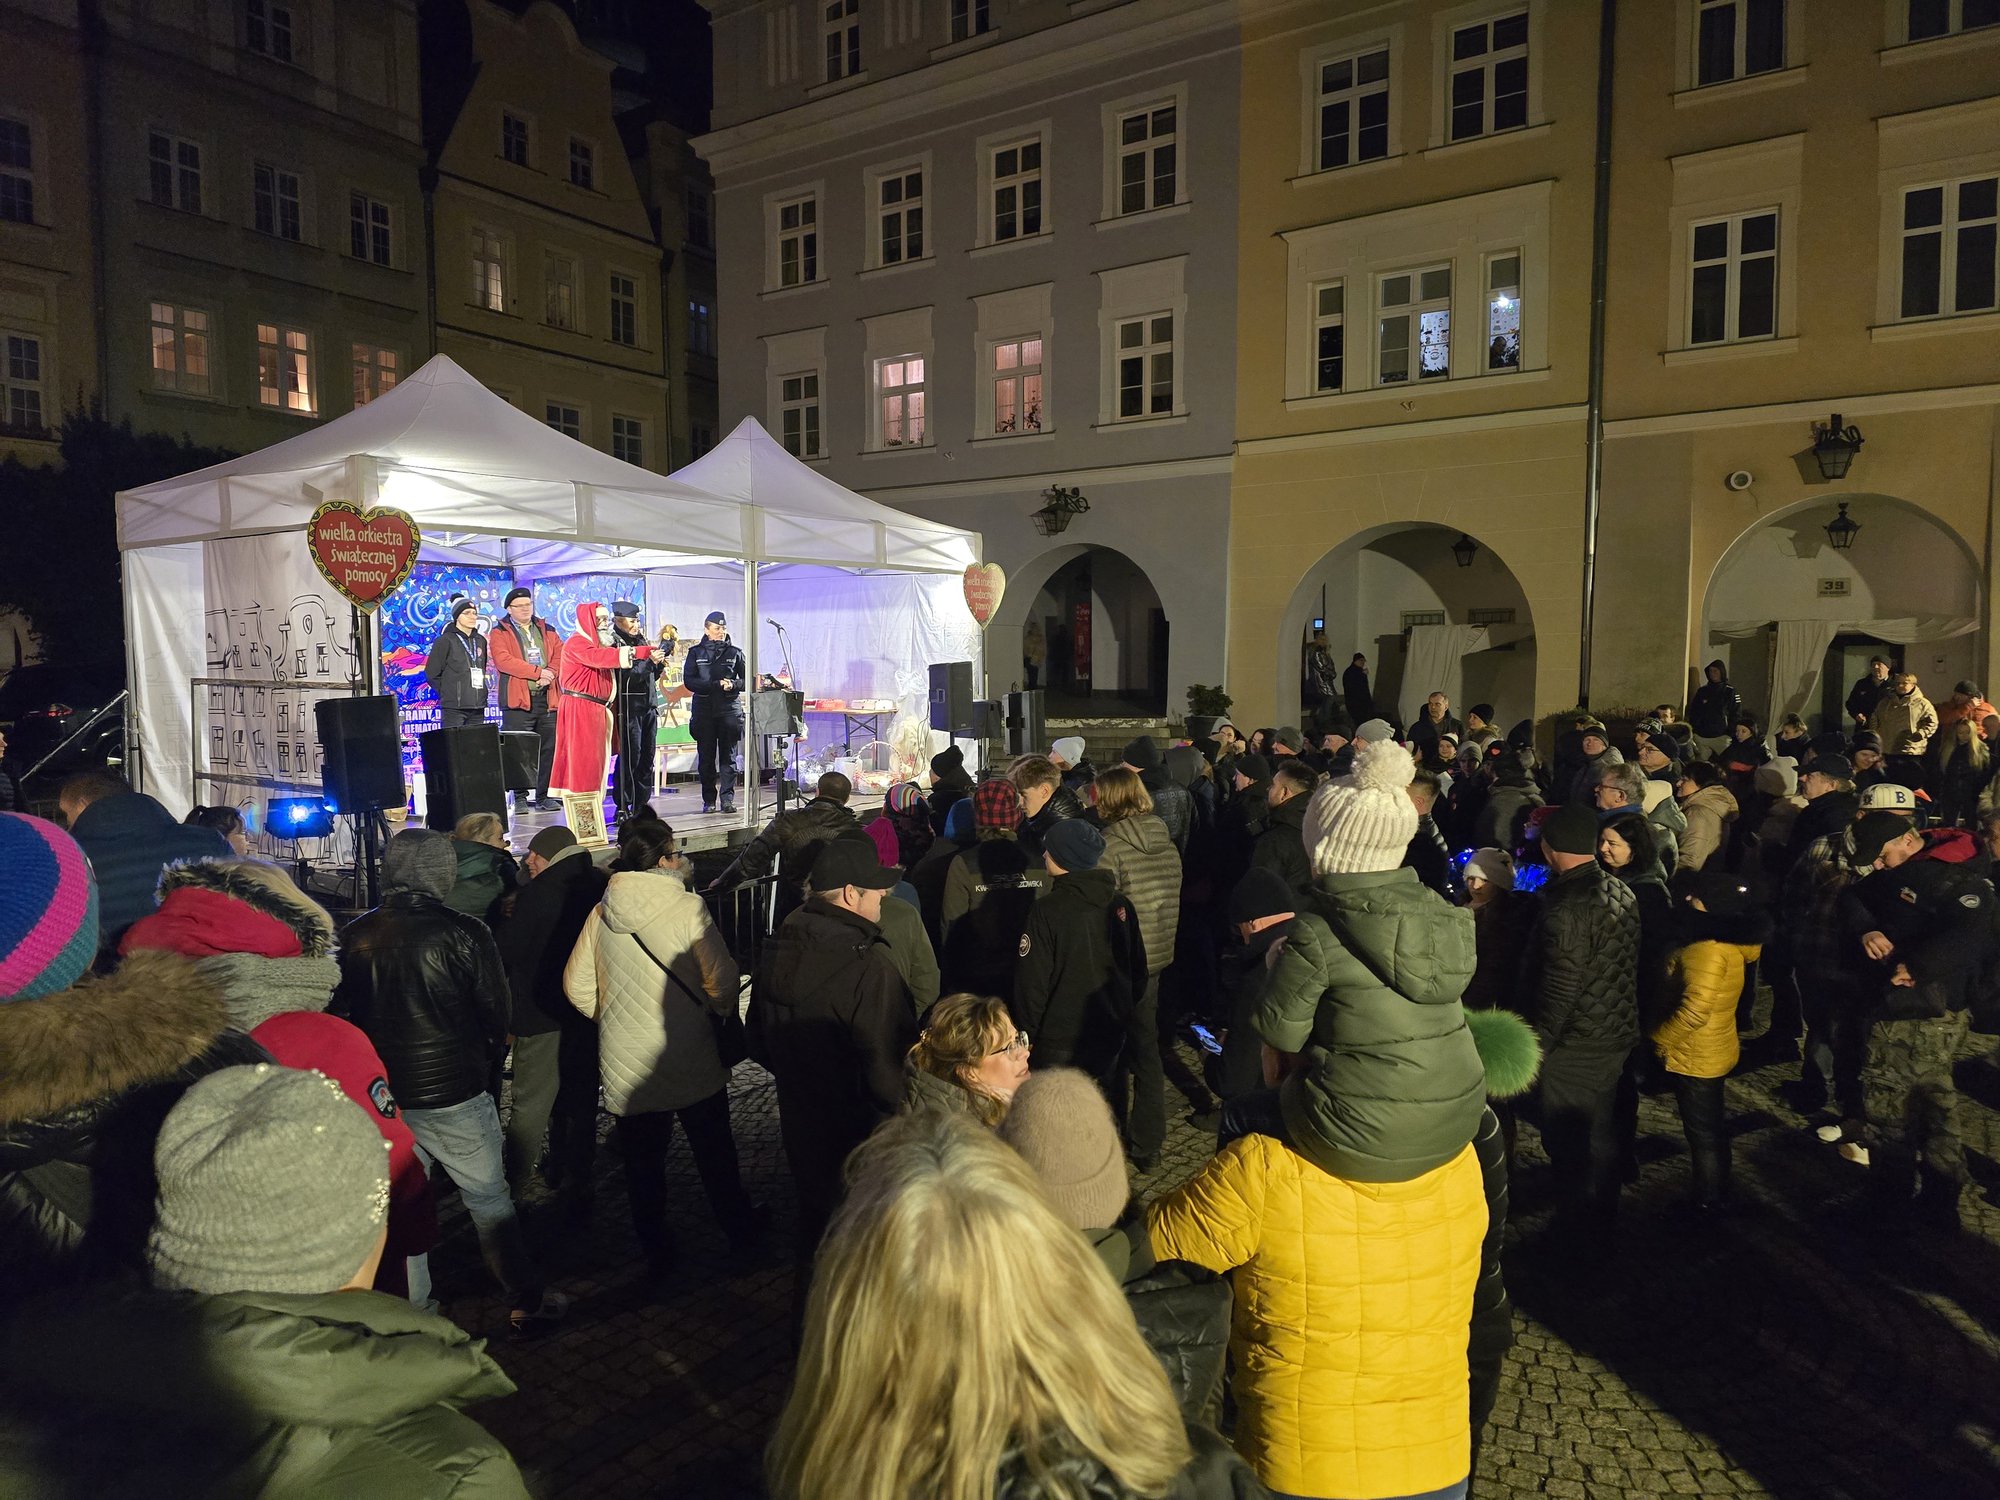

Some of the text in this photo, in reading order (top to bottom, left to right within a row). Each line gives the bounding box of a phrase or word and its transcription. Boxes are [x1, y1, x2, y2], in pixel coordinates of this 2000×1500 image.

[319, 522, 403, 546] wielka orkiestra
[331, 544, 397, 573] świątecznej
[345, 568, 388, 589] pomocy
[1824, 581, 1845, 590] 39
[1895, 791, 1906, 803] B
